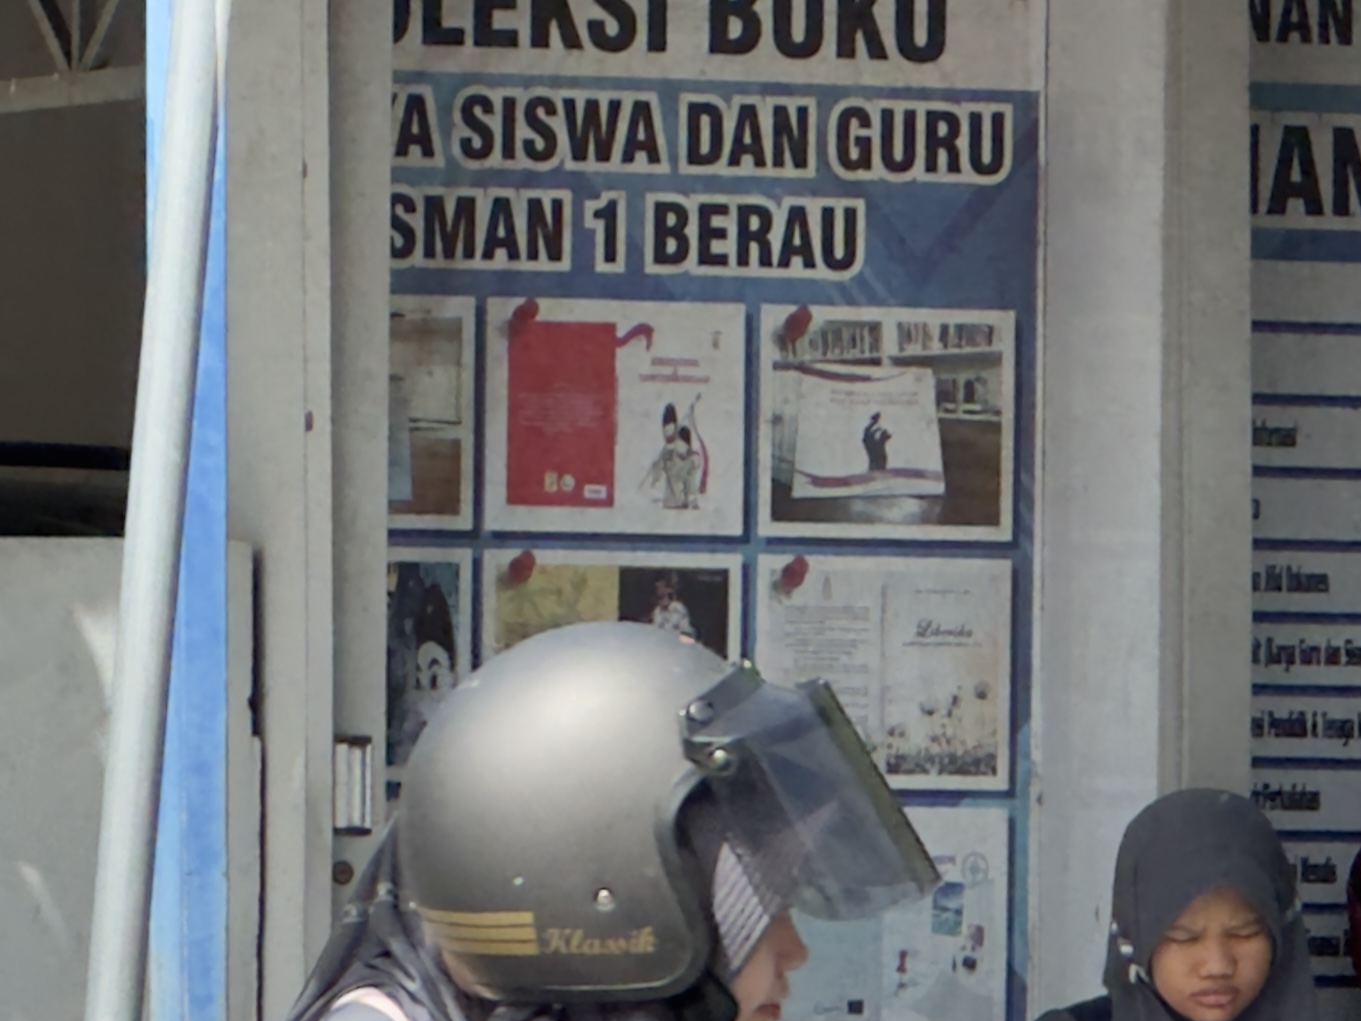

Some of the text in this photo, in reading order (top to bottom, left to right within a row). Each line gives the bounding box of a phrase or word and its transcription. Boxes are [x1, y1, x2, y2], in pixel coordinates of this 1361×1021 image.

[391, 0, 668, 53] LEKSI
[391, 92, 1005, 176] A SISWA DAN GURU
[390, 192, 858, 271] SMAN 1 BERAU
